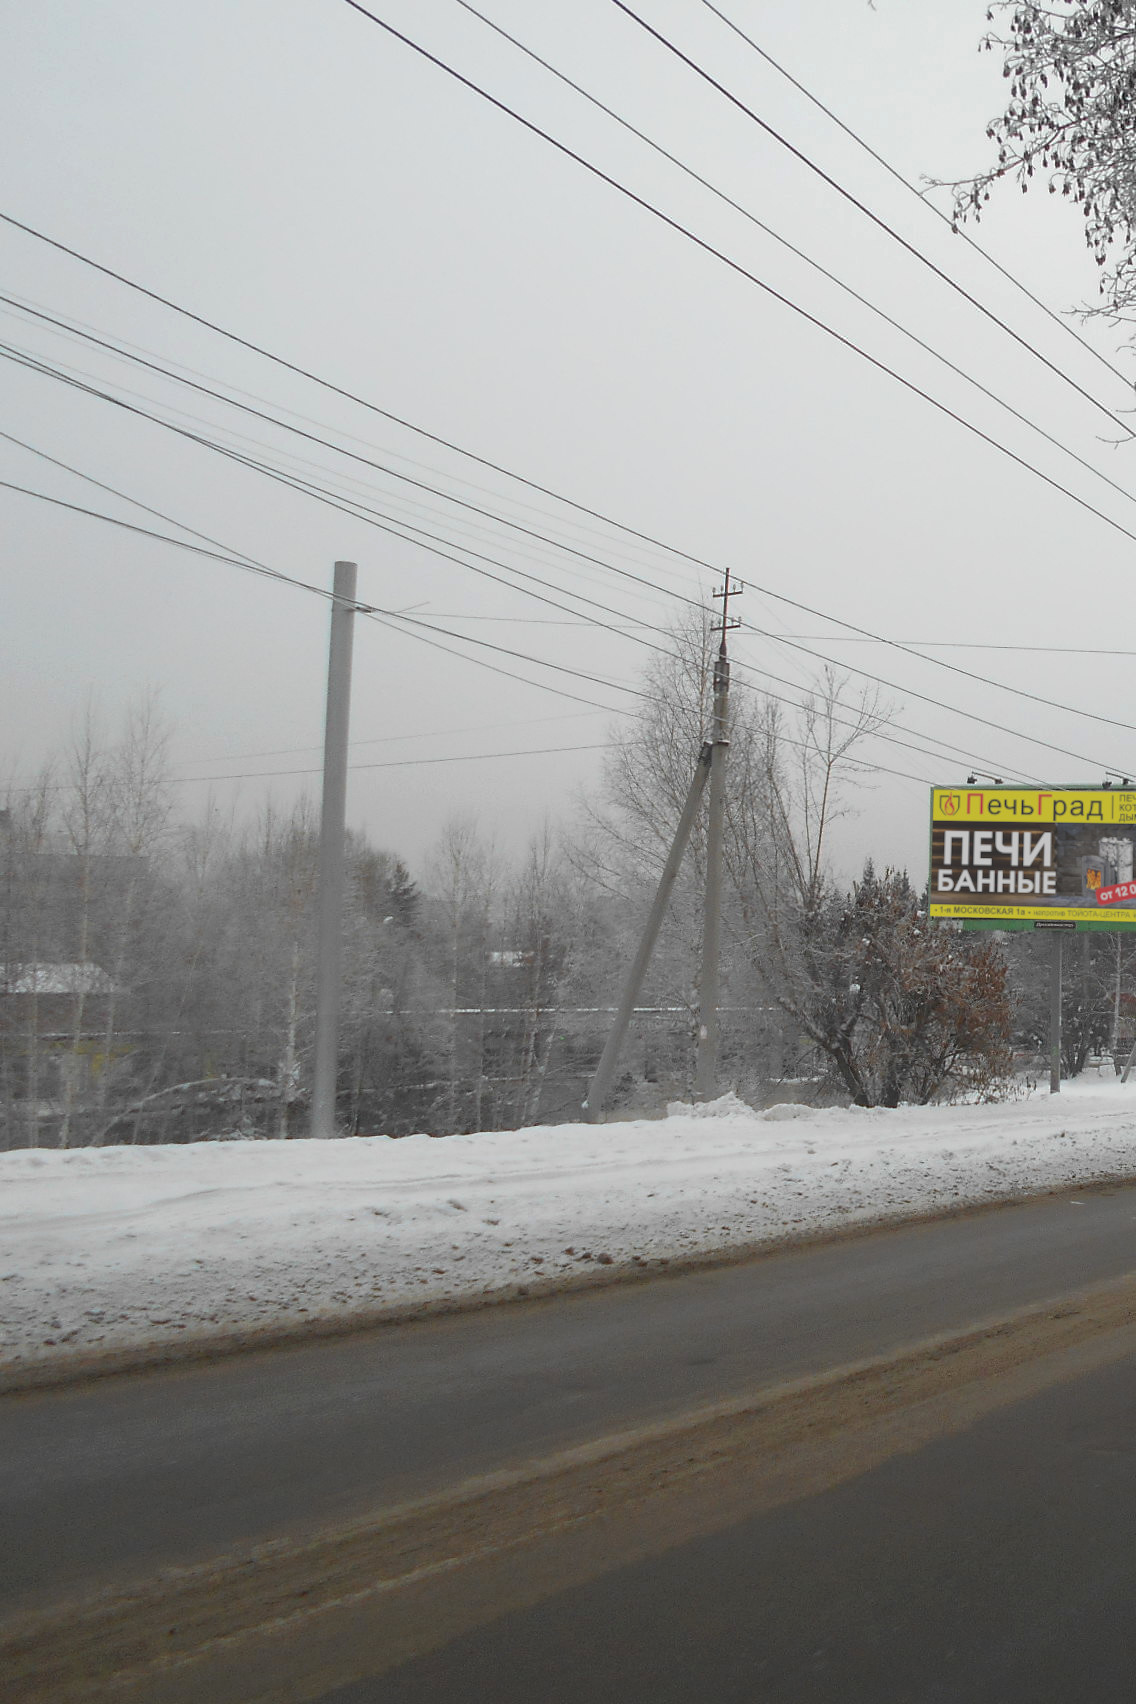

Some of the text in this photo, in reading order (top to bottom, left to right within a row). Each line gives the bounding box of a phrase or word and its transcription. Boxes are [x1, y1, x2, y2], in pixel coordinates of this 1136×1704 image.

[967, 793, 1103, 821] ПечьГрад
[943, 830, 1053, 867] ПЕЧИ
[937, 869, 1057, 895] БАННЫЕ
[1100, 890, 1113, 901] от
[1115, 885, 1128, 897] 12
[953, 906, 1014, 916] МОСКОВСКАЯ
